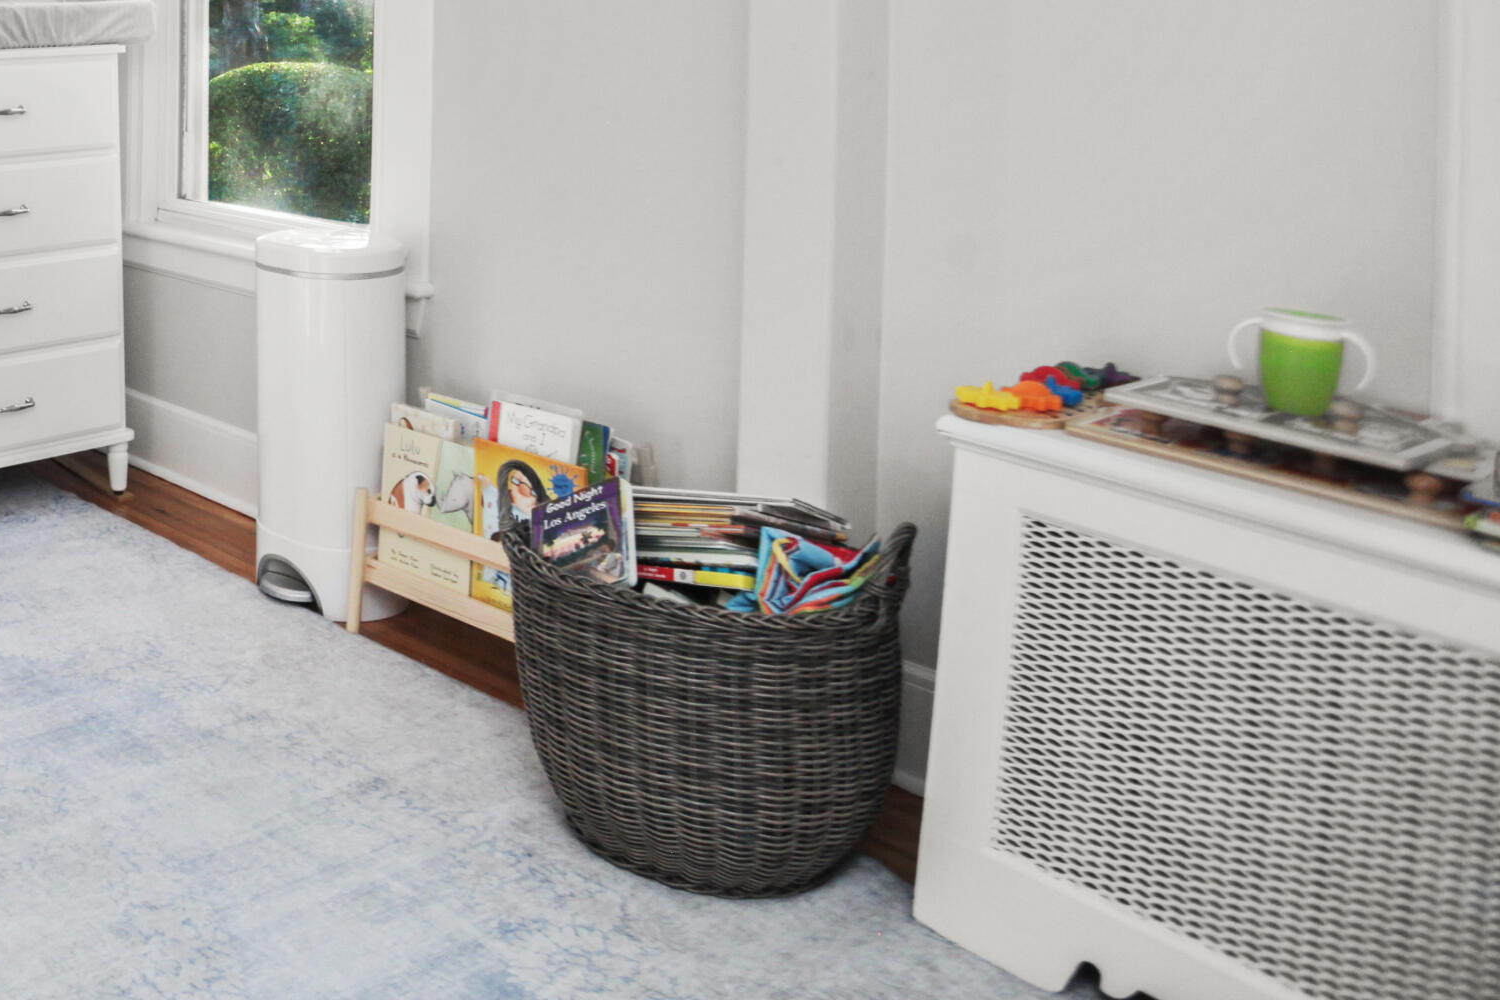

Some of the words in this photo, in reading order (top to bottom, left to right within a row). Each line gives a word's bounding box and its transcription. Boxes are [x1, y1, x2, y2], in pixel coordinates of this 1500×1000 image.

[524, 414, 566, 438] Grandpa
[545, 496, 573, 514] Good
[573, 485, 604, 503] Night
[543, 517, 562, 530] Los
[564, 501, 607, 523] Angeles
